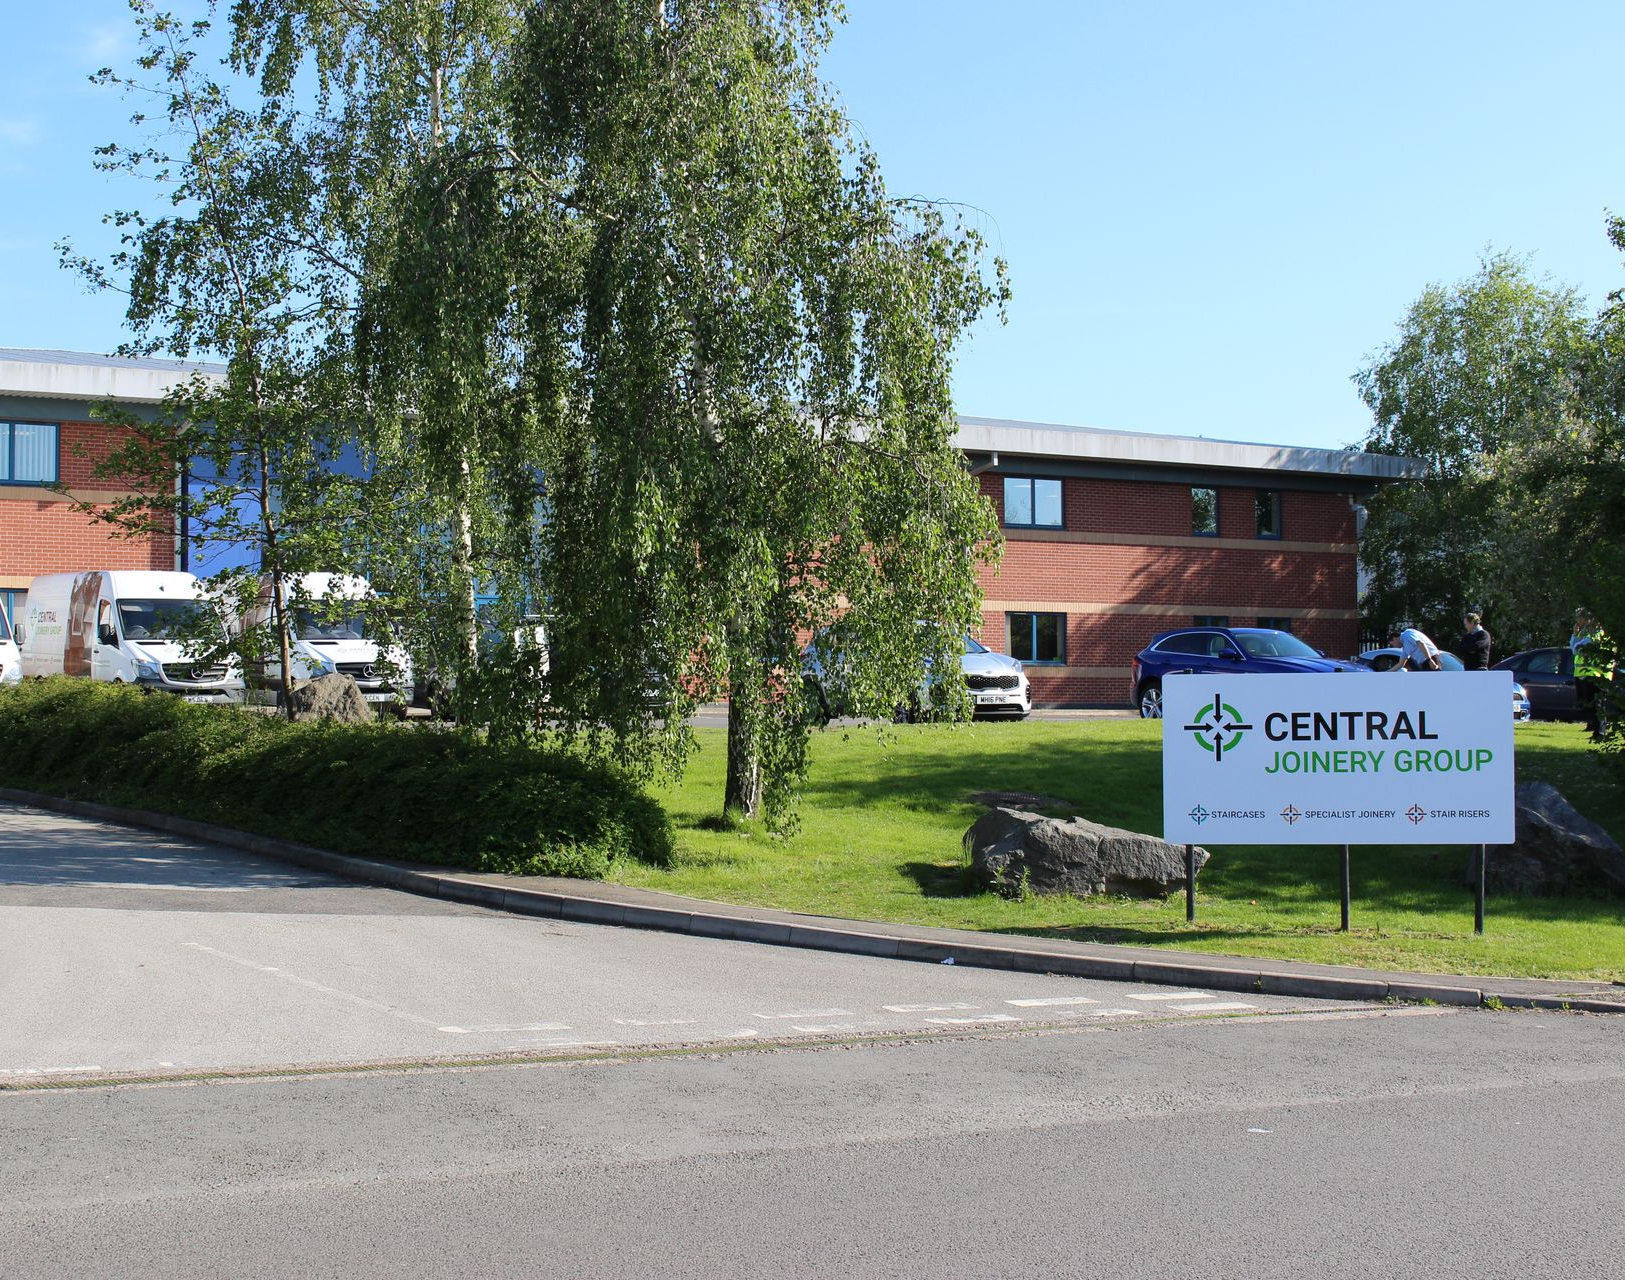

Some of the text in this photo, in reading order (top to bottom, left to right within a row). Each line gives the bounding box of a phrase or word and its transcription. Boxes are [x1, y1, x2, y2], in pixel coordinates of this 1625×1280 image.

[37, 611, 57, 623] CENTRAL
[1264, 710, 1439, 742] CENTRAL
[1264, 748, 1493, 774] JOINERY GROUP
[1210, 810, 1266, 819] STAIRCASES
[1304, 810, 1396, 819] SPECIALIST JOINERY
[1429, 810, 1490, 818] STAIR RISERS
